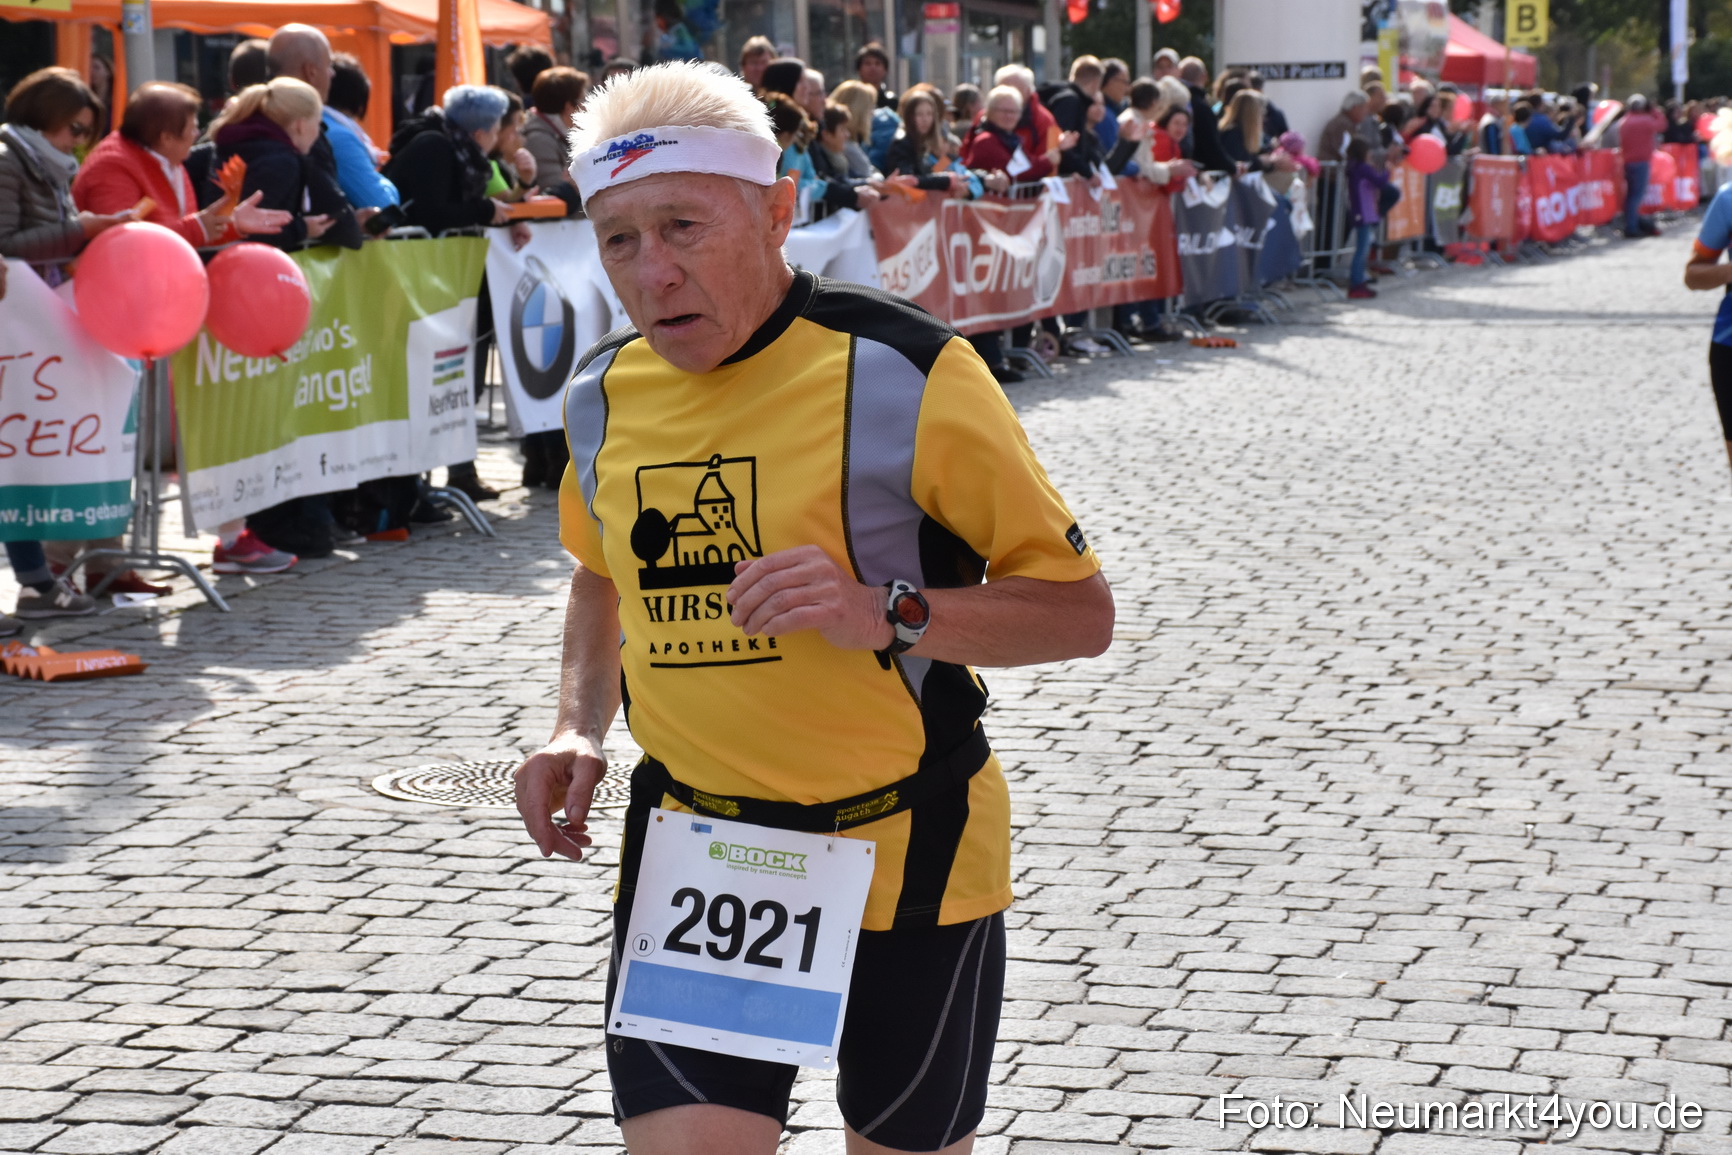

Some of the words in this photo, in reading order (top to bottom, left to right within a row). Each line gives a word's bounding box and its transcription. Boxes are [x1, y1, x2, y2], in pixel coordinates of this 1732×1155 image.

[1518, 4, 1537, 32] B
[642, 592, 734, 623] HIRS
[649, 636, 778, 655] APOTHEKE
[834, 807, 871, 823] Augath
[728, 843, 808, 873] BOCK
[726, 863, 749, 873] inspired
[750, 865, 758, 874] by
[759, 868, 778, 876] smart
[778, 871, 807, 880] concepts
[662, 886, 822, 974] 2921
[639, 938, 648, 951] D
